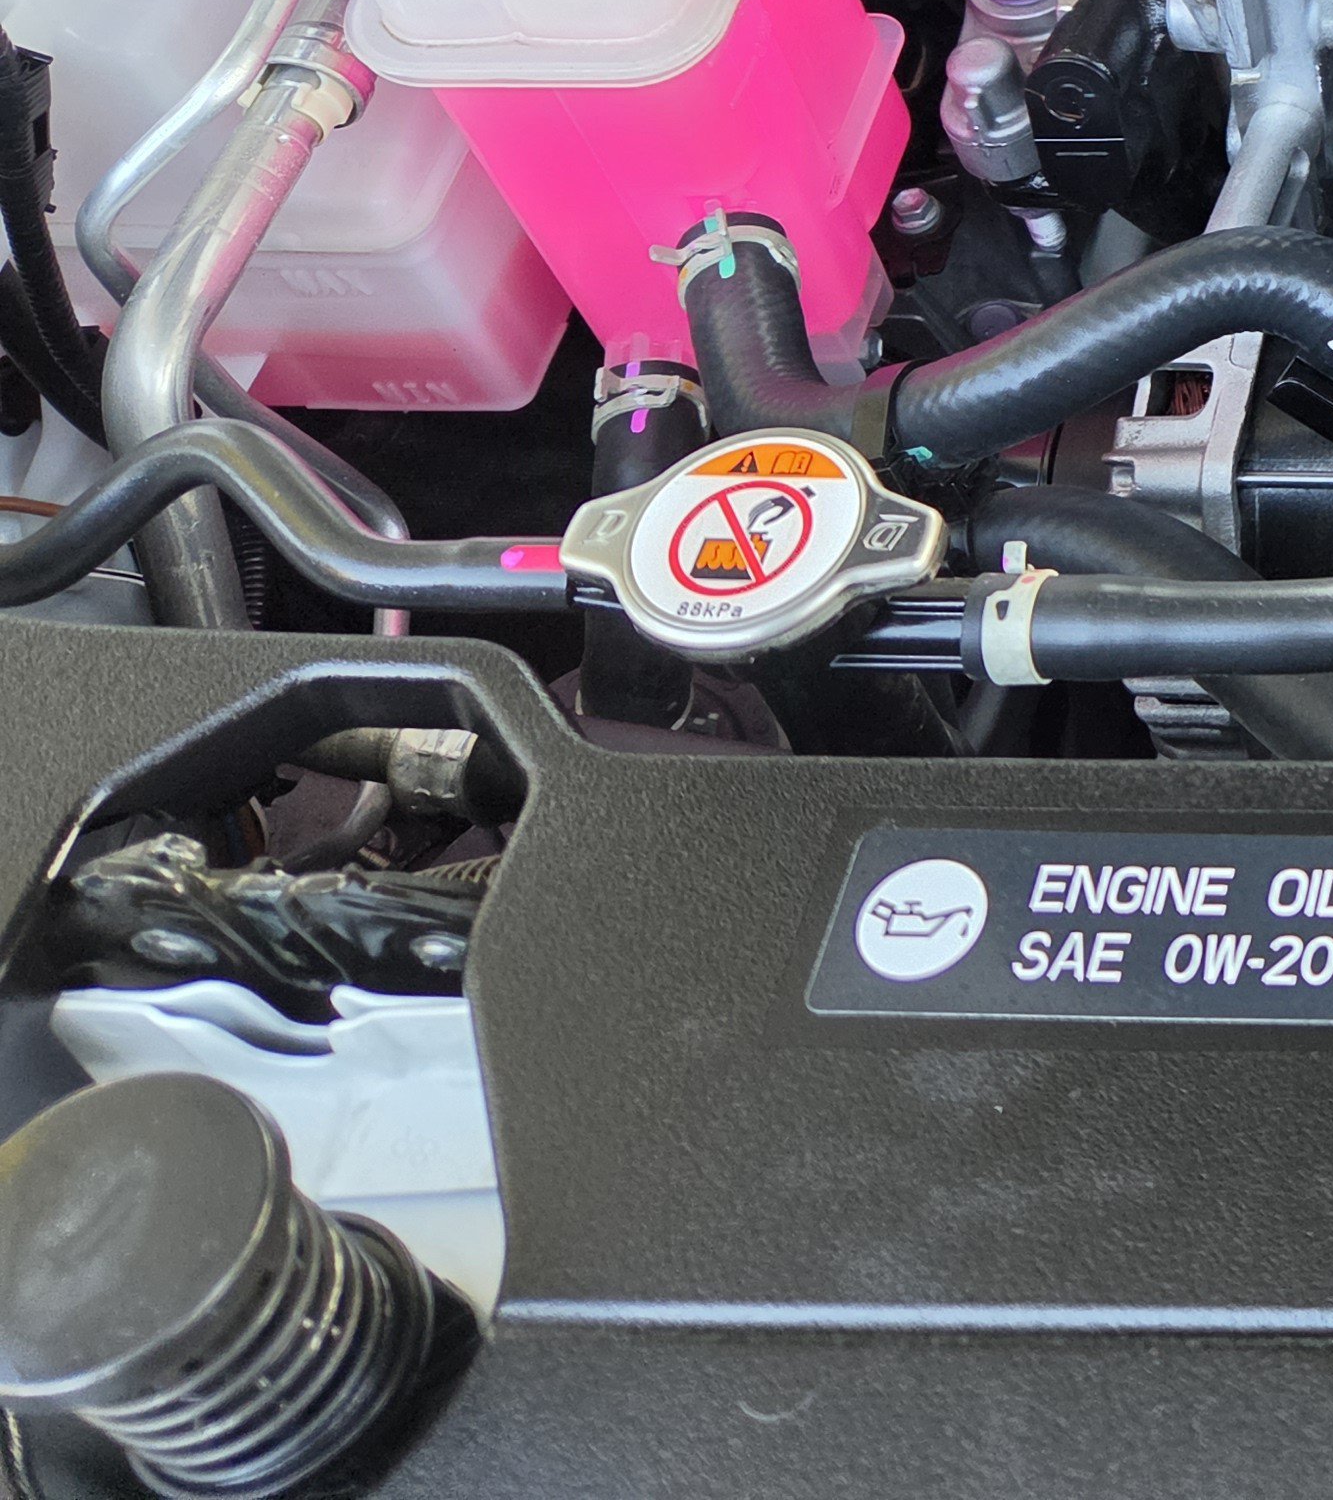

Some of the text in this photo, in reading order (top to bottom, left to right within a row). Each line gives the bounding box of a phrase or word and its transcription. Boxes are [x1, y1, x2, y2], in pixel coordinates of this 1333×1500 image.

[279, 268, 374, 297] MAX
[371, 380, 461, 405] MIN
[675, 600, 744, 619] 88kPa
[1028, 862, 1237, 917] ENGINE
[1010, 930, 1133, 984] SAE
